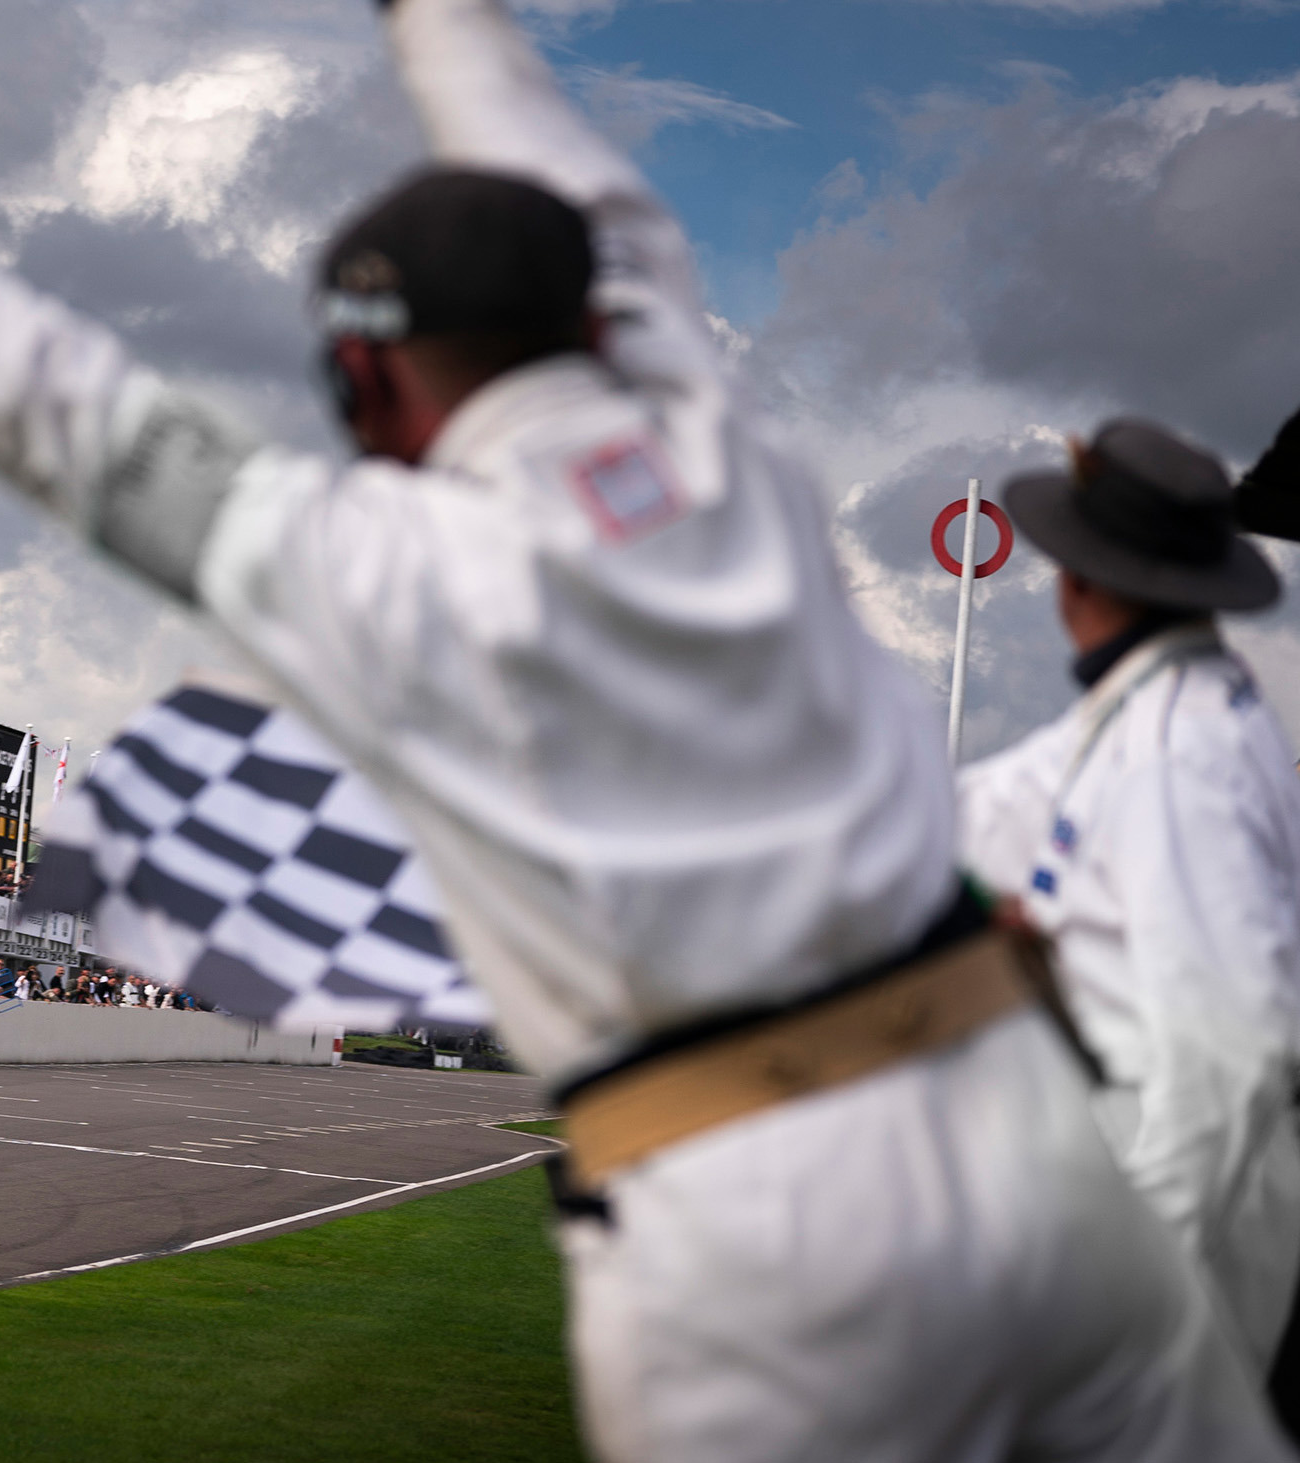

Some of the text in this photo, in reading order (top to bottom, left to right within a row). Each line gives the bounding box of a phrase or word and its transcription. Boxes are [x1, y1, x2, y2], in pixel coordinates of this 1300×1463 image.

[3, 943, 15, 953] 21
[19, 946, 32, 956] 22
[36, 950, 48, 959] 23
[51, 953, 62, 962] 24
